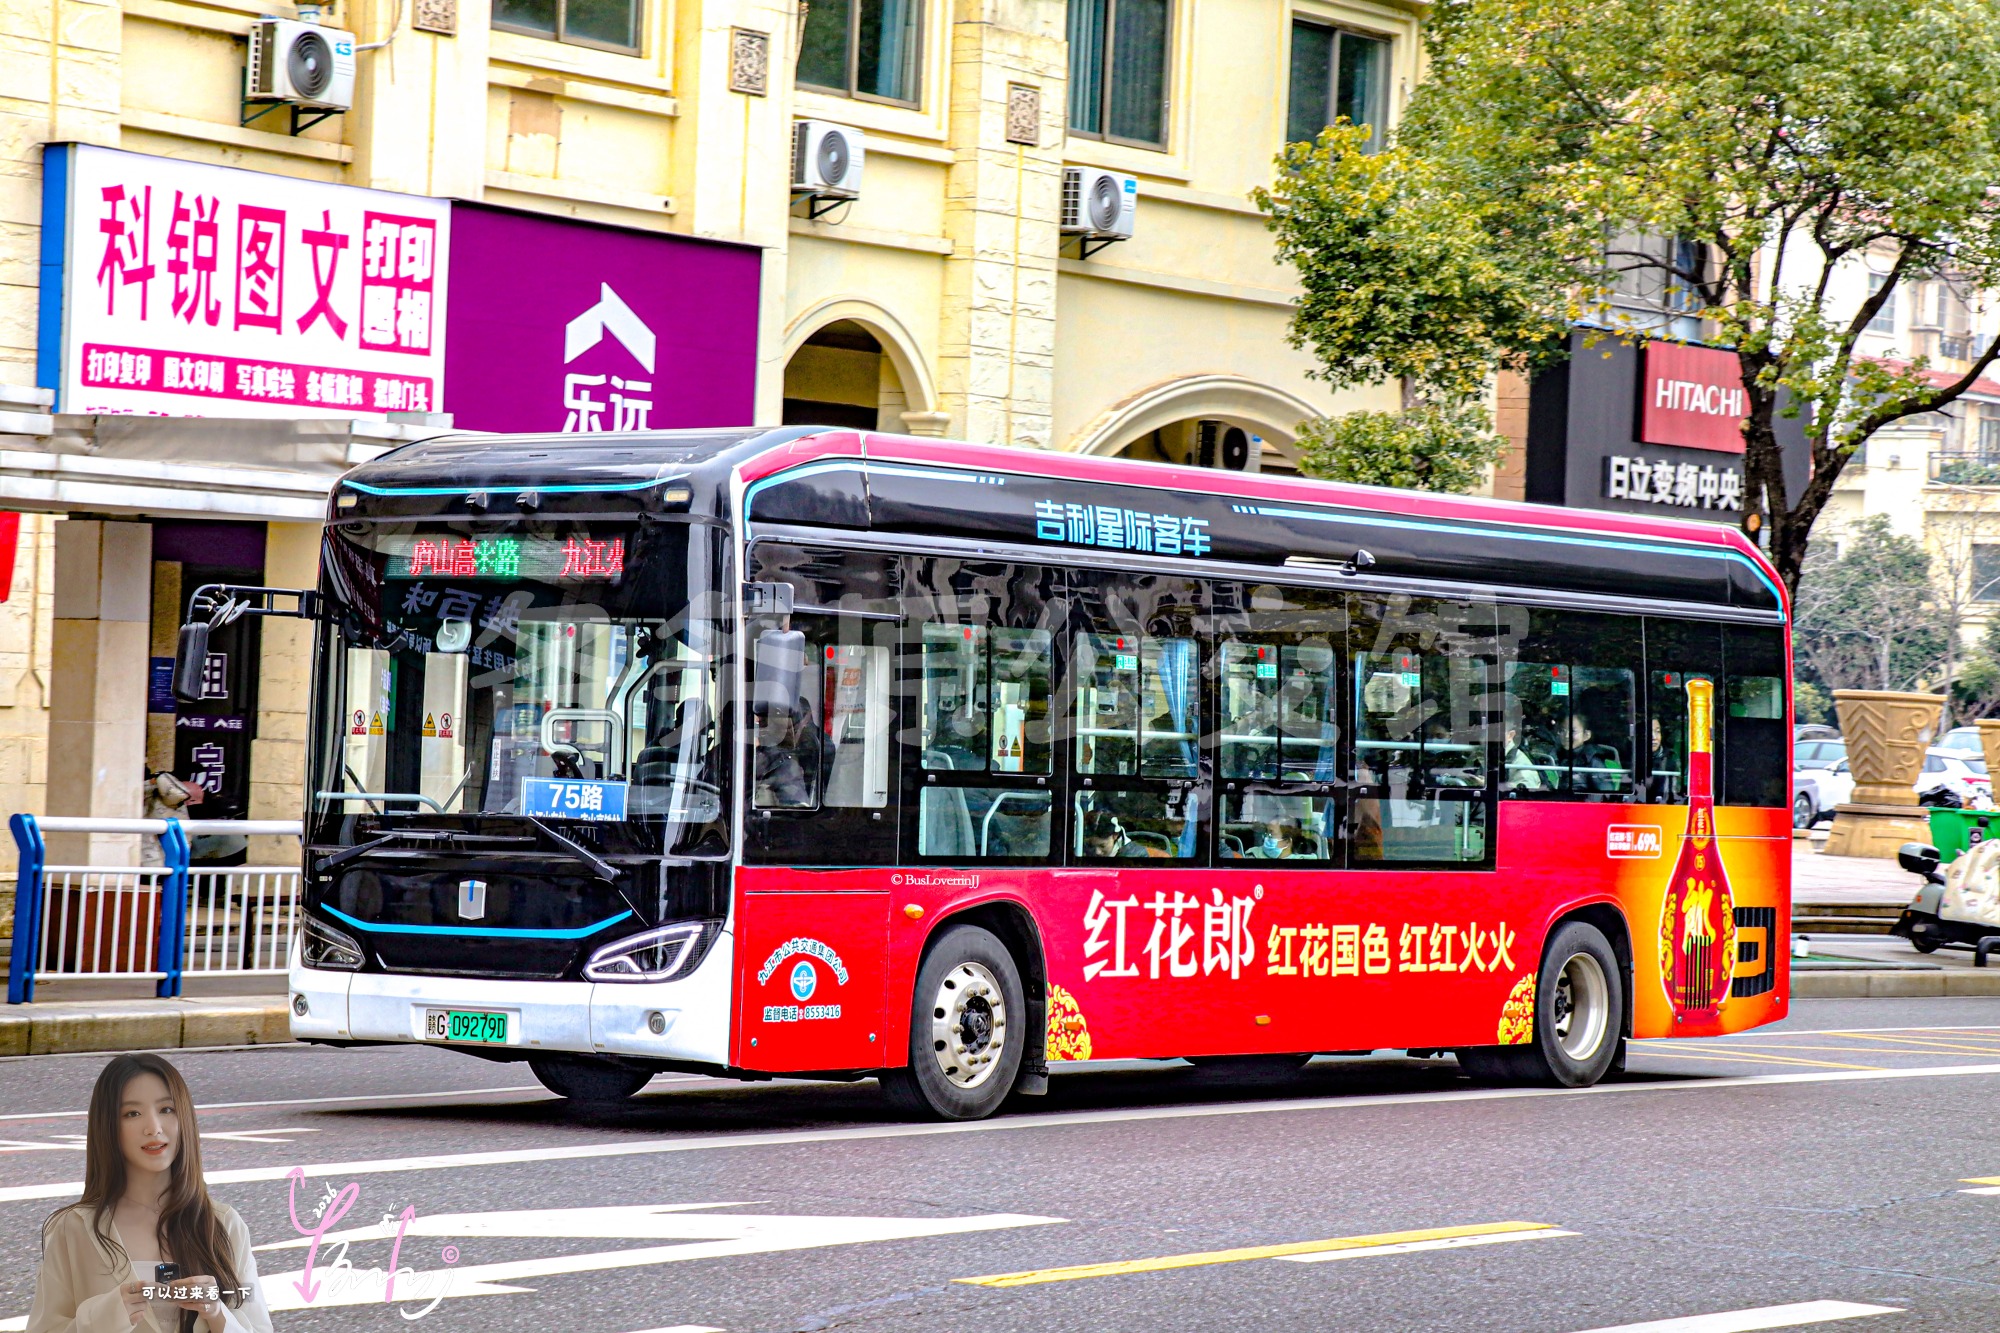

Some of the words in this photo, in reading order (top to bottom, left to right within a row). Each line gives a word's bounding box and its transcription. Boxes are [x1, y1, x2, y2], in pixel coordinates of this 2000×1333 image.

[97, 184, 349, 338] 科锐图文
[365, 219, 433, 282] 打印
[88, 349, 151, 386] 打印复印
[562, 373, 653, 433] 乐远
[1656, 378, 1742, 417] HITACHI
[1034, 499, 1211, 556] 吉利星际客车
[549, 784, 603, 811] 75路
[757, 937, 849, 987] 九江市公共交通集团公司
[1267, 922, 1391, 978] 红花国色
[1399, 920, 1516, 975] 红红火火
